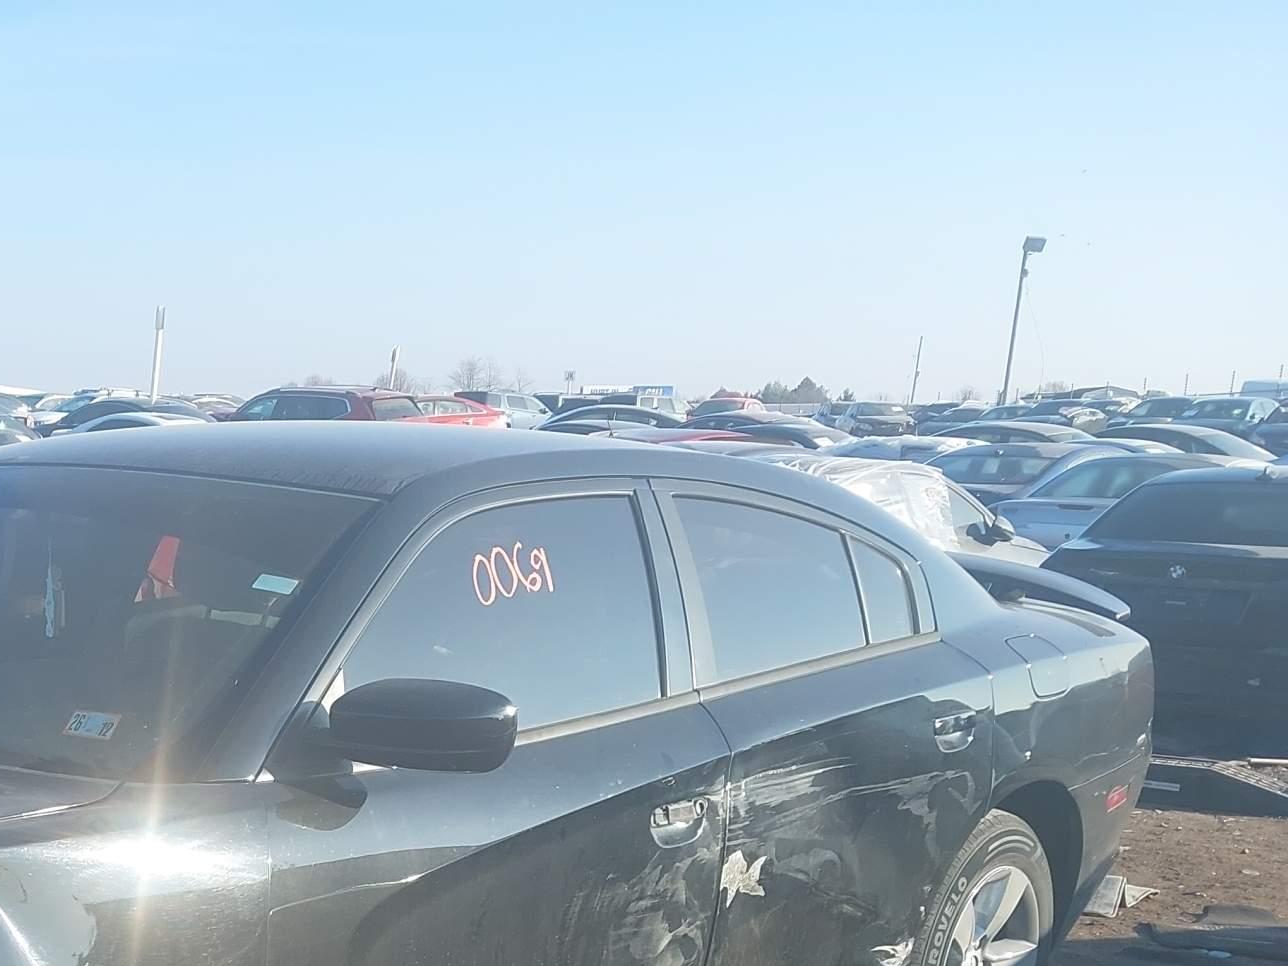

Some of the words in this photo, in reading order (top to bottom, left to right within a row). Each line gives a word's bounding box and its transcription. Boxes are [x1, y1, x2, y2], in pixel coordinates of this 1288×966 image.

[472, 541, 554, 606] 0069
[68, 713, 87, 731] 26
[97, 721, 115, 737] 12
[928, 876, 968, 965] ROVELO
